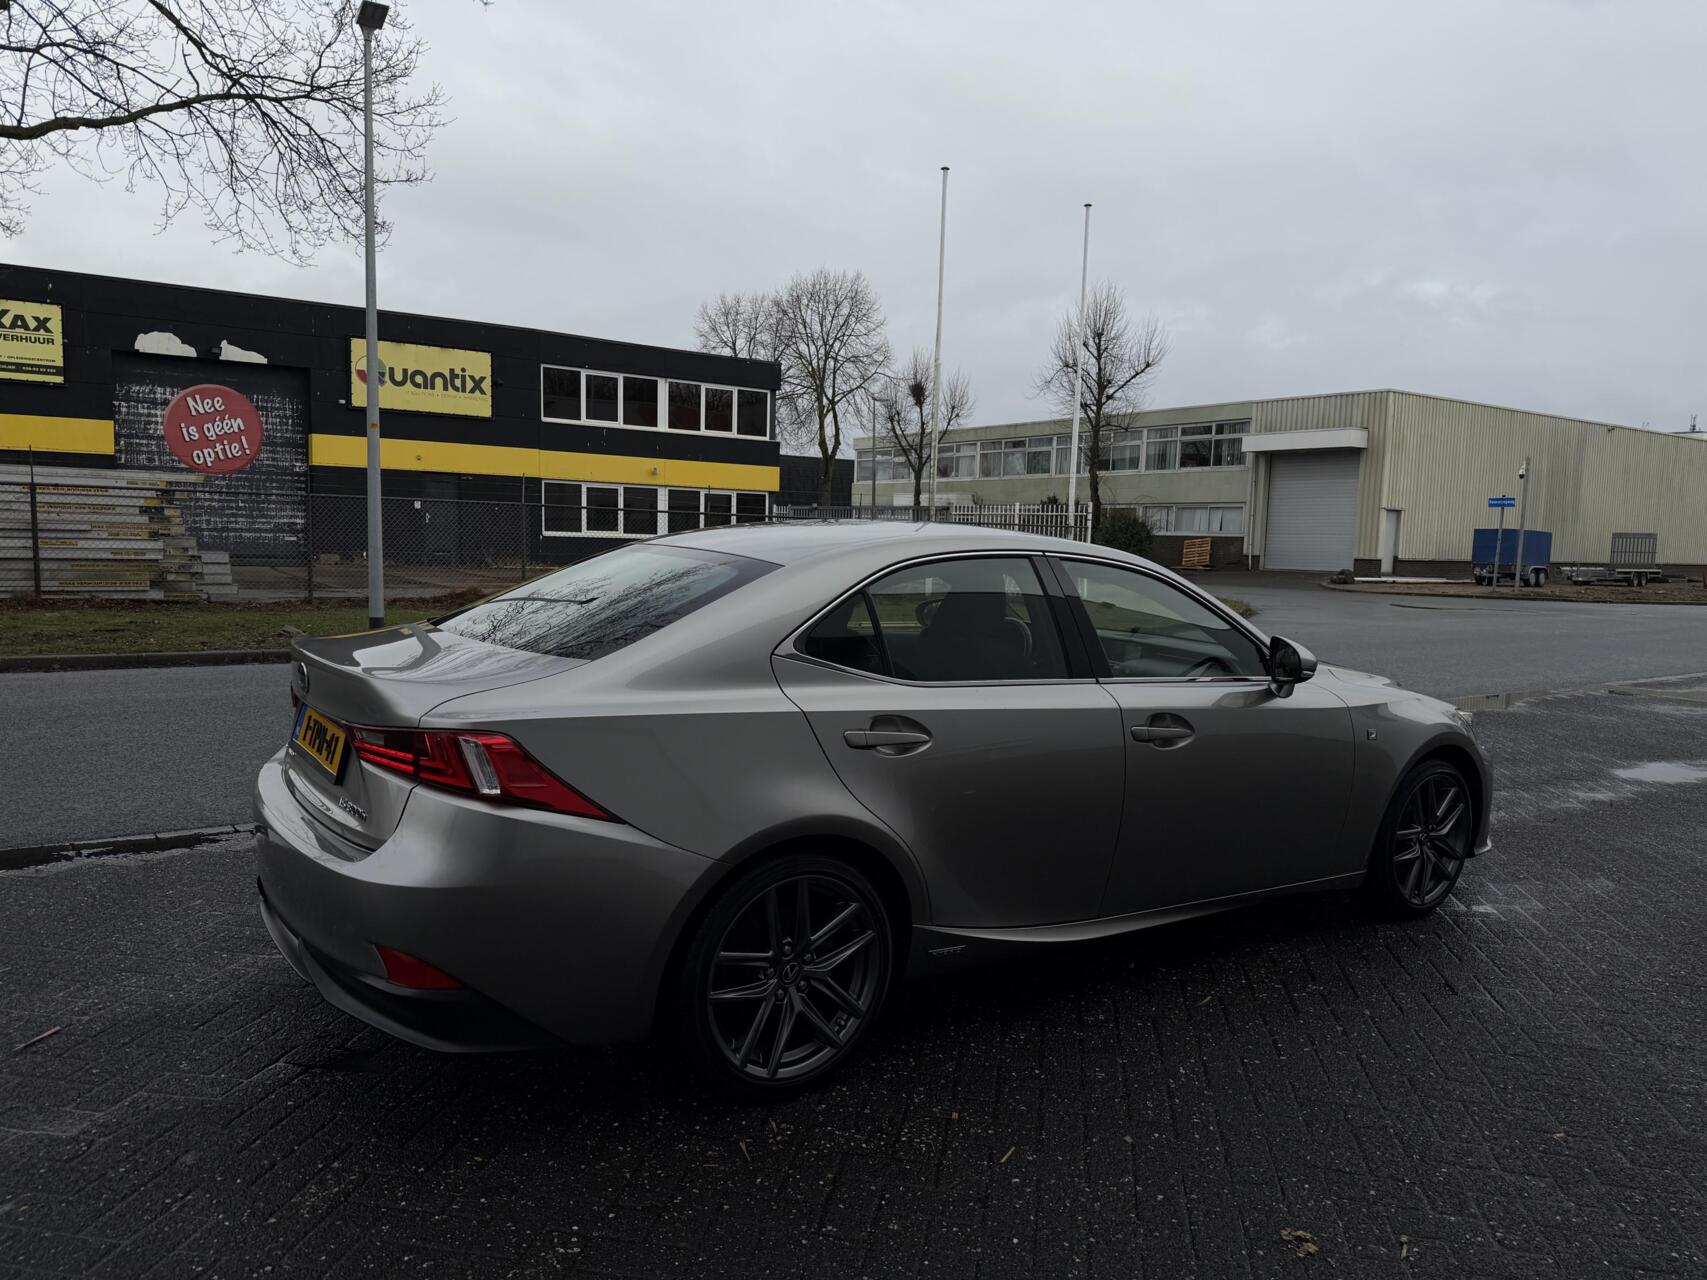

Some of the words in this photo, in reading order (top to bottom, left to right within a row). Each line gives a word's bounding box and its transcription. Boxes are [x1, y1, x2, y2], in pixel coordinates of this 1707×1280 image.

[186, 394, 225, 416] Nee
[181, 422, 199, 441] is
[203, 414, 245, 441] géén
[192, 435, 251, 467] optie!
